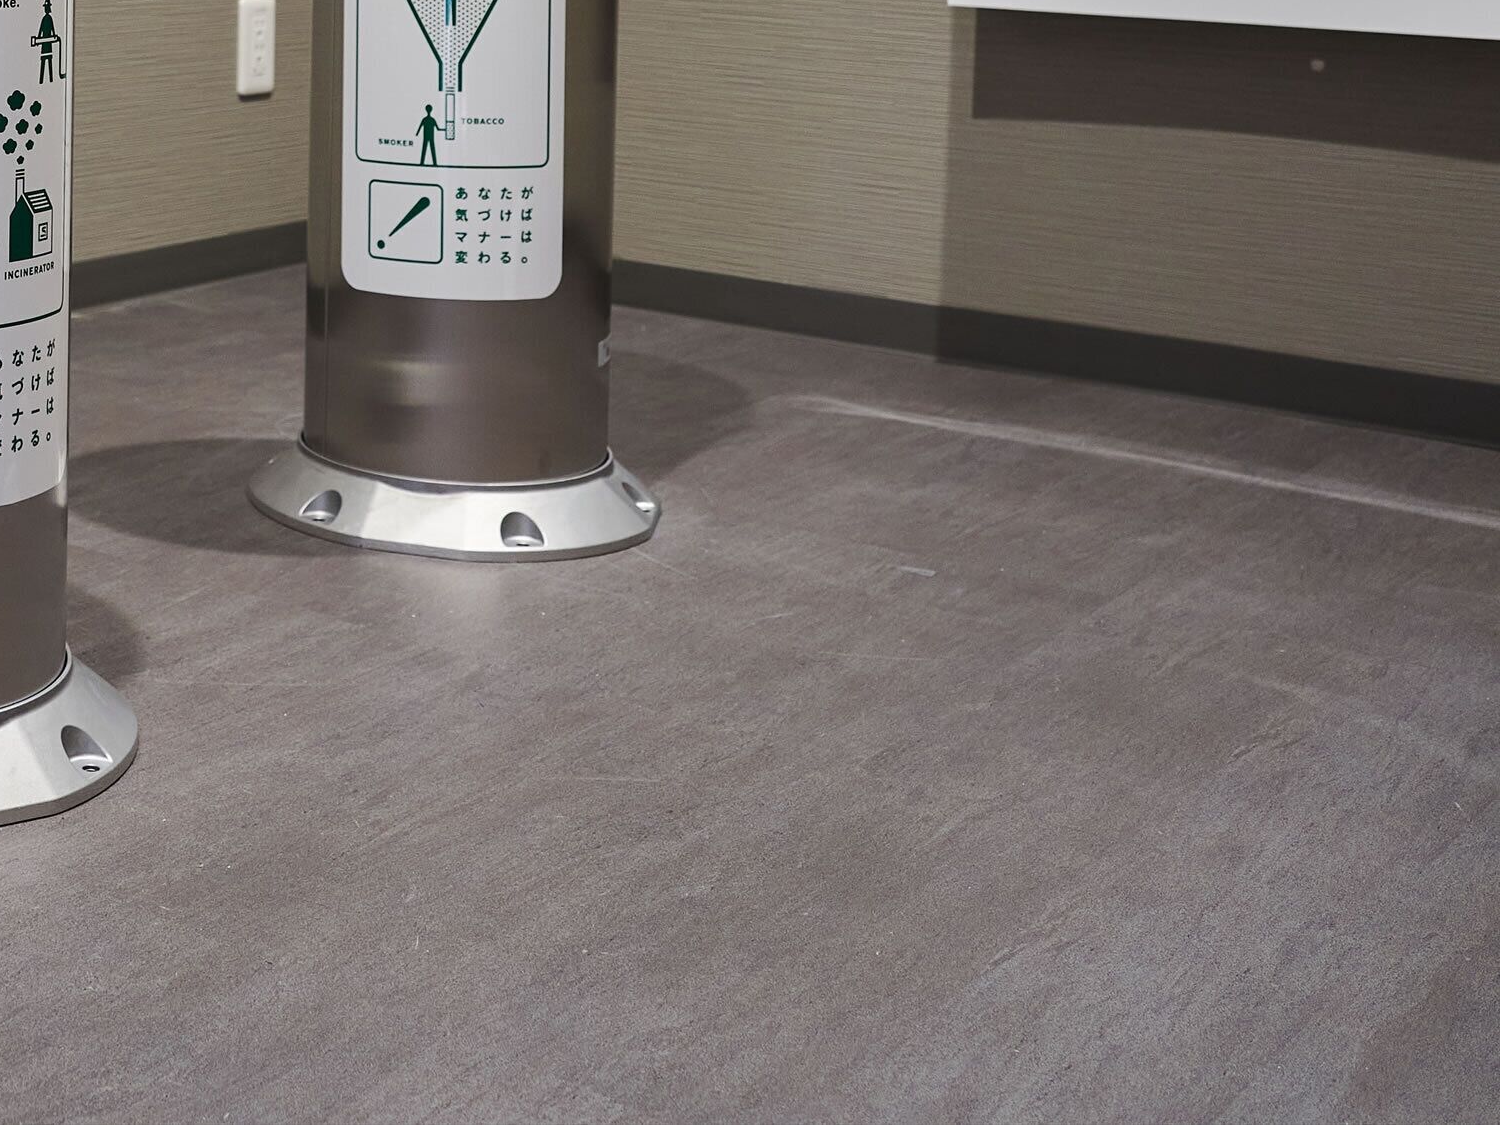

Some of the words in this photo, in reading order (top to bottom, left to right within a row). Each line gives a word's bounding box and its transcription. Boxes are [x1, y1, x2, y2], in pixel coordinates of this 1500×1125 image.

[378, 138, 414, 146] SMOKER
[455, 186, 533, 200] あなたが
[455, 208, 532, 222] 気づけば
[455, 231, 532, 243] マナーは
[455, 252, 529, 264] 変わる。
[4, 261, 54, 280] INCINERATOR
